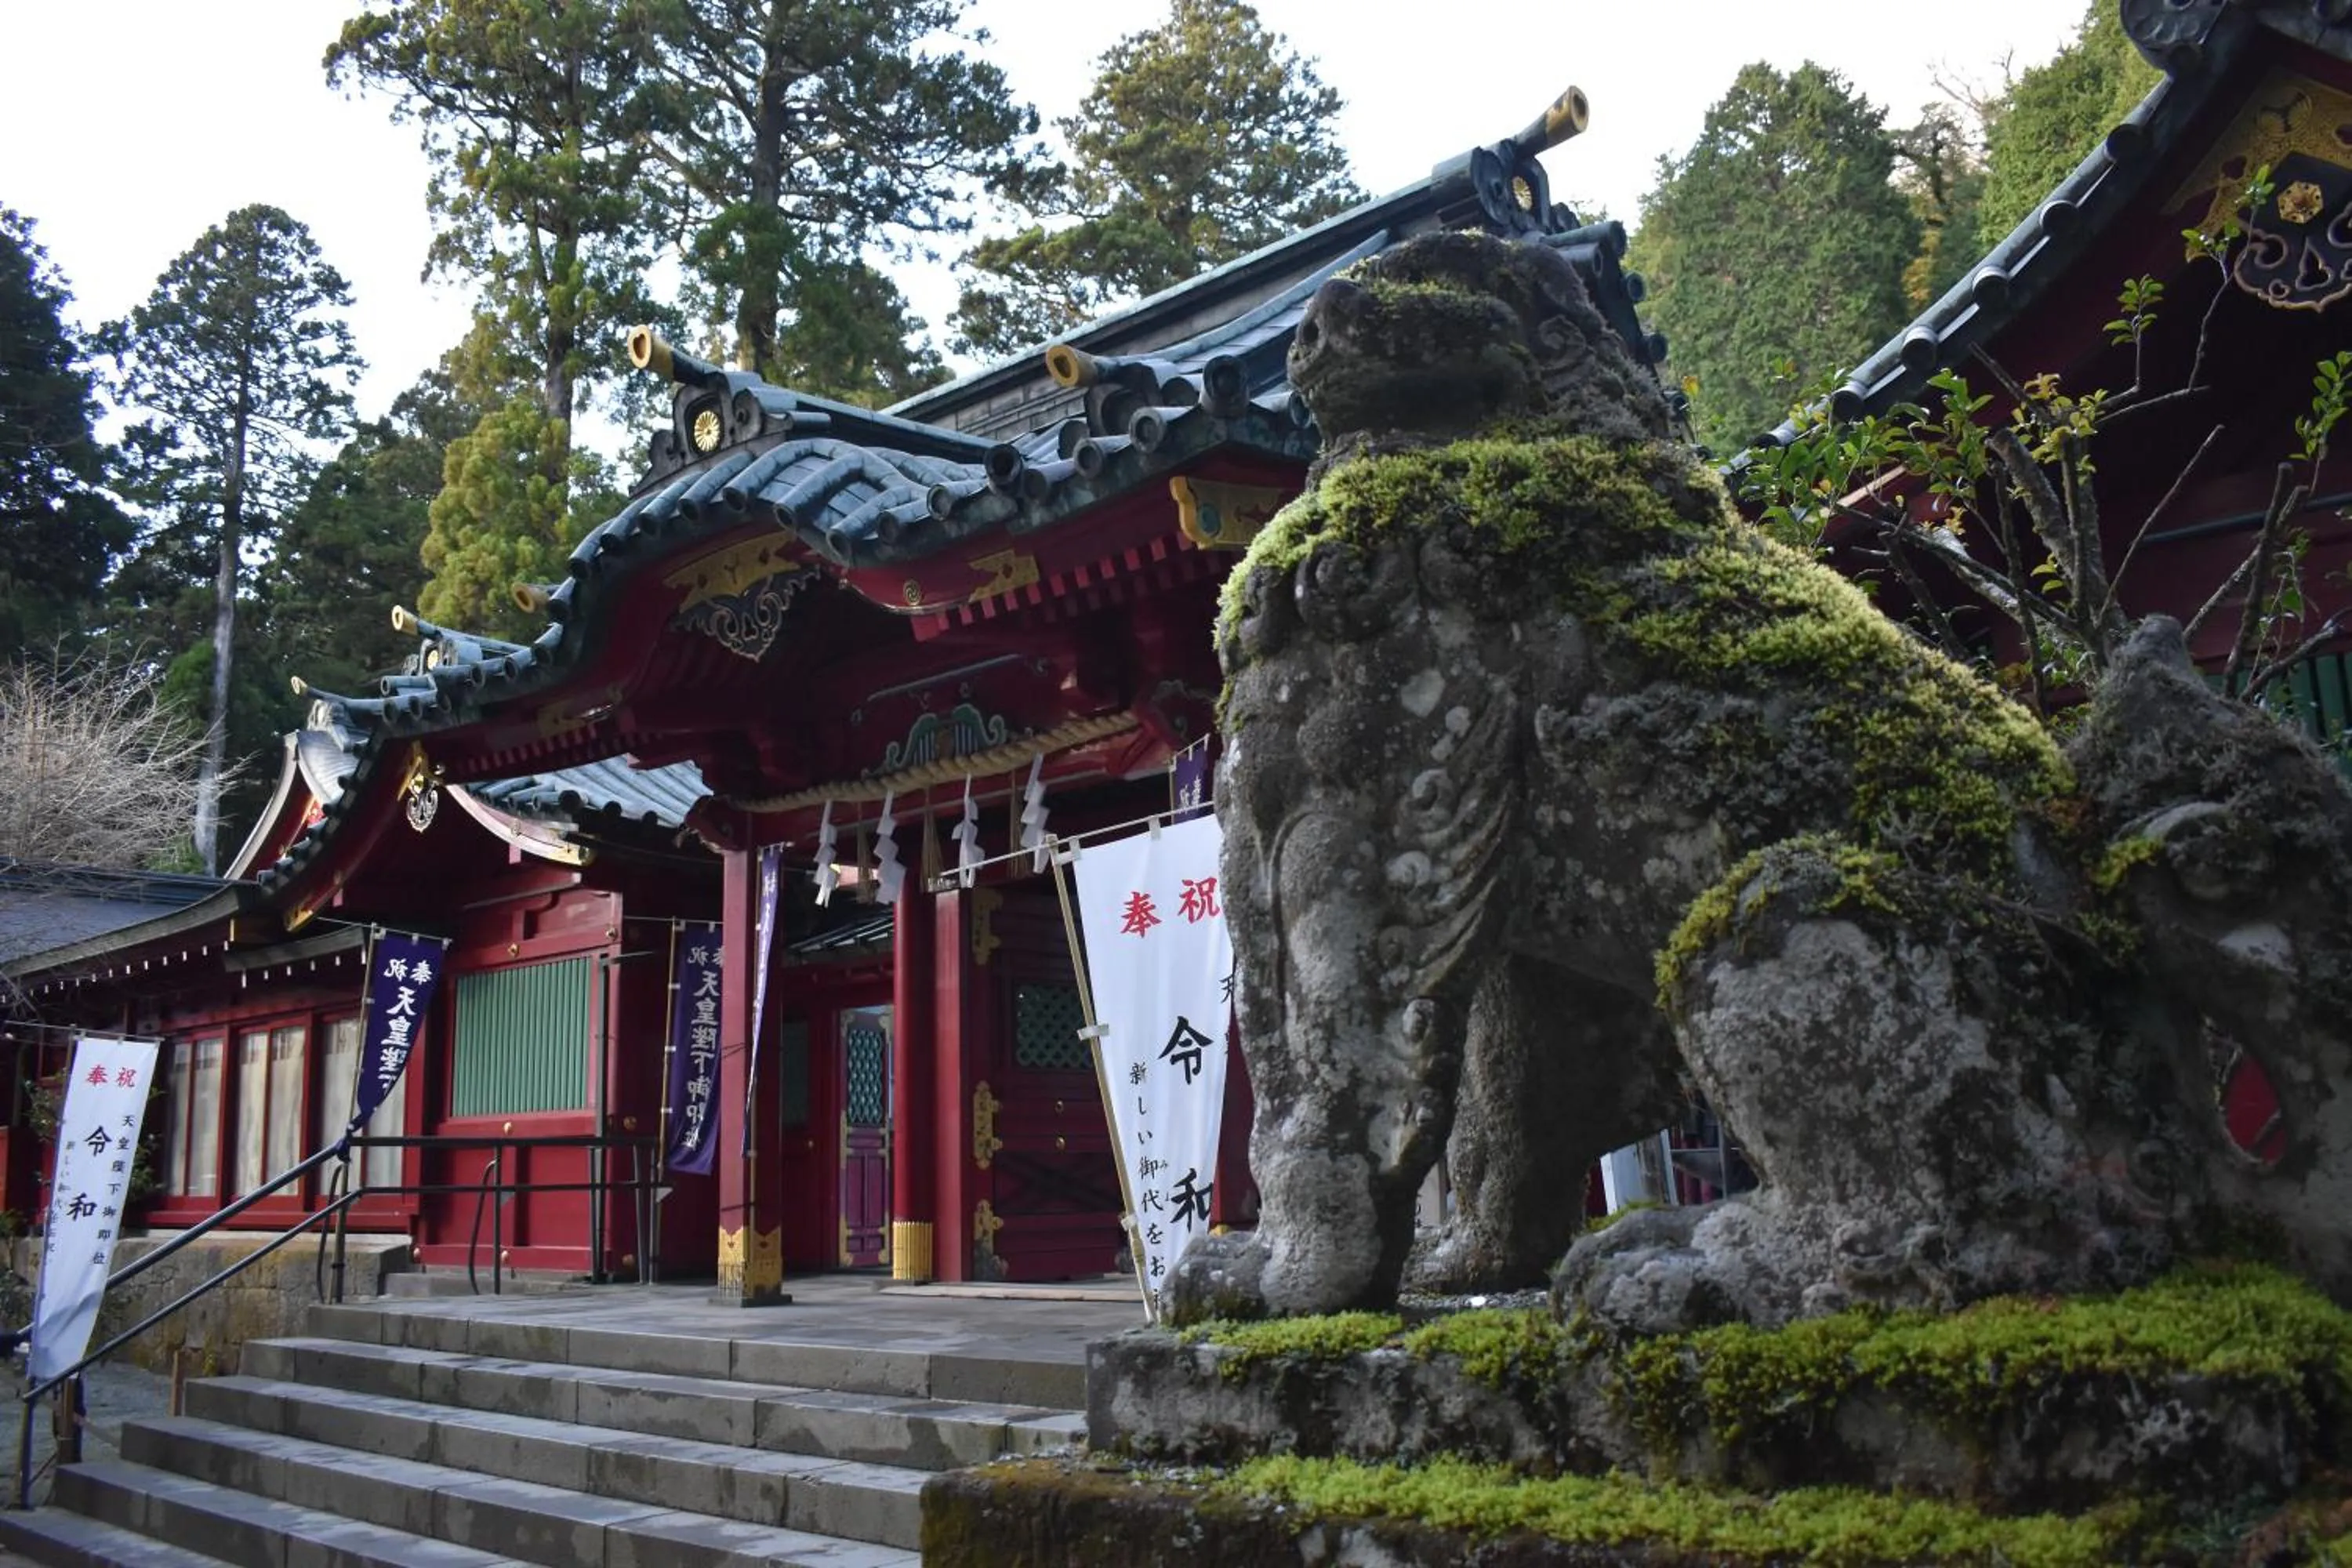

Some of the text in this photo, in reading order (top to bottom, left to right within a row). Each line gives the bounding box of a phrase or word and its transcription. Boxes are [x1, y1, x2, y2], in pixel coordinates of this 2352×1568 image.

[1120, 876, 1221, 938] 奉祝
[86, 1064, 137, 1087] 奉祝
[1156, 1015, 1214, 1233] 令和
[66, 1125, 112, 1221] 令和
